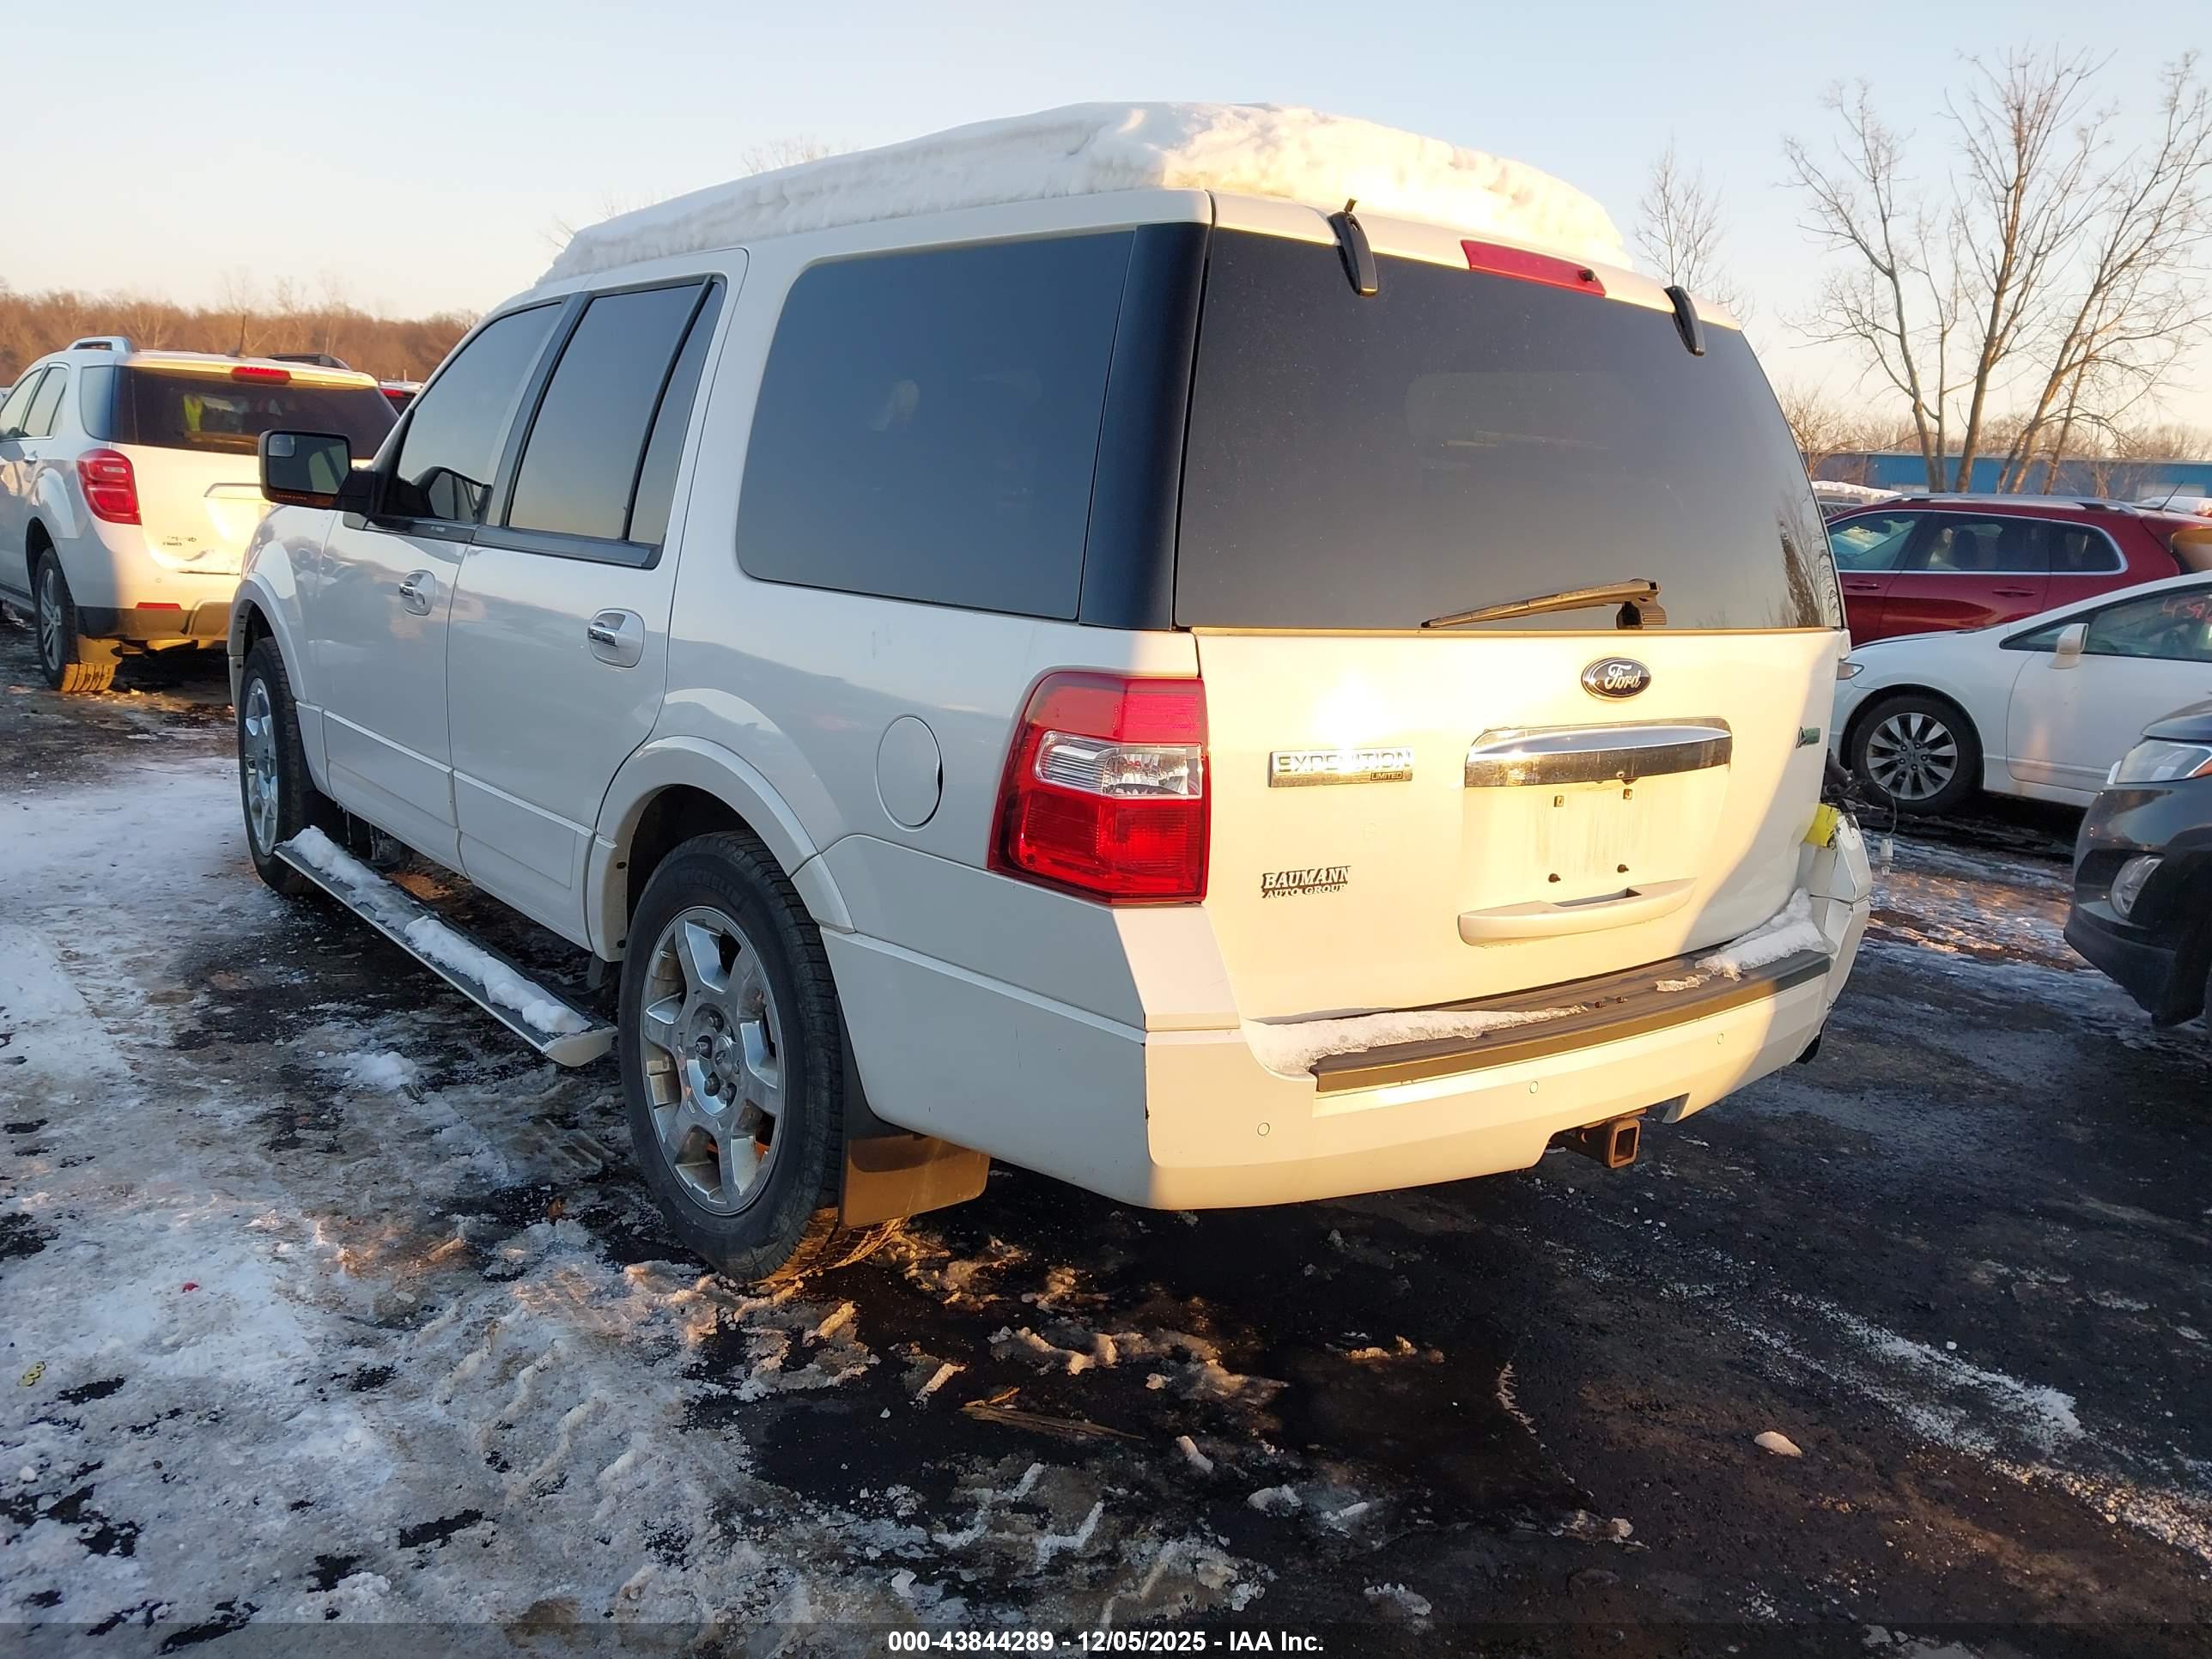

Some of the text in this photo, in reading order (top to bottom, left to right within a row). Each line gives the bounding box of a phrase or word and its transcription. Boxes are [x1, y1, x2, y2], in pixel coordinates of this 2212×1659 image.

[1604, 663, 1642, 690] Ford
[1277, 748, 1412, 774] EXPEITION
[1371, 772, 1403, 781] LIMITED
[1261, 866, 1351, 890] BAUMANN
[1262, 883, 1346, 899] AUTO GROUP
